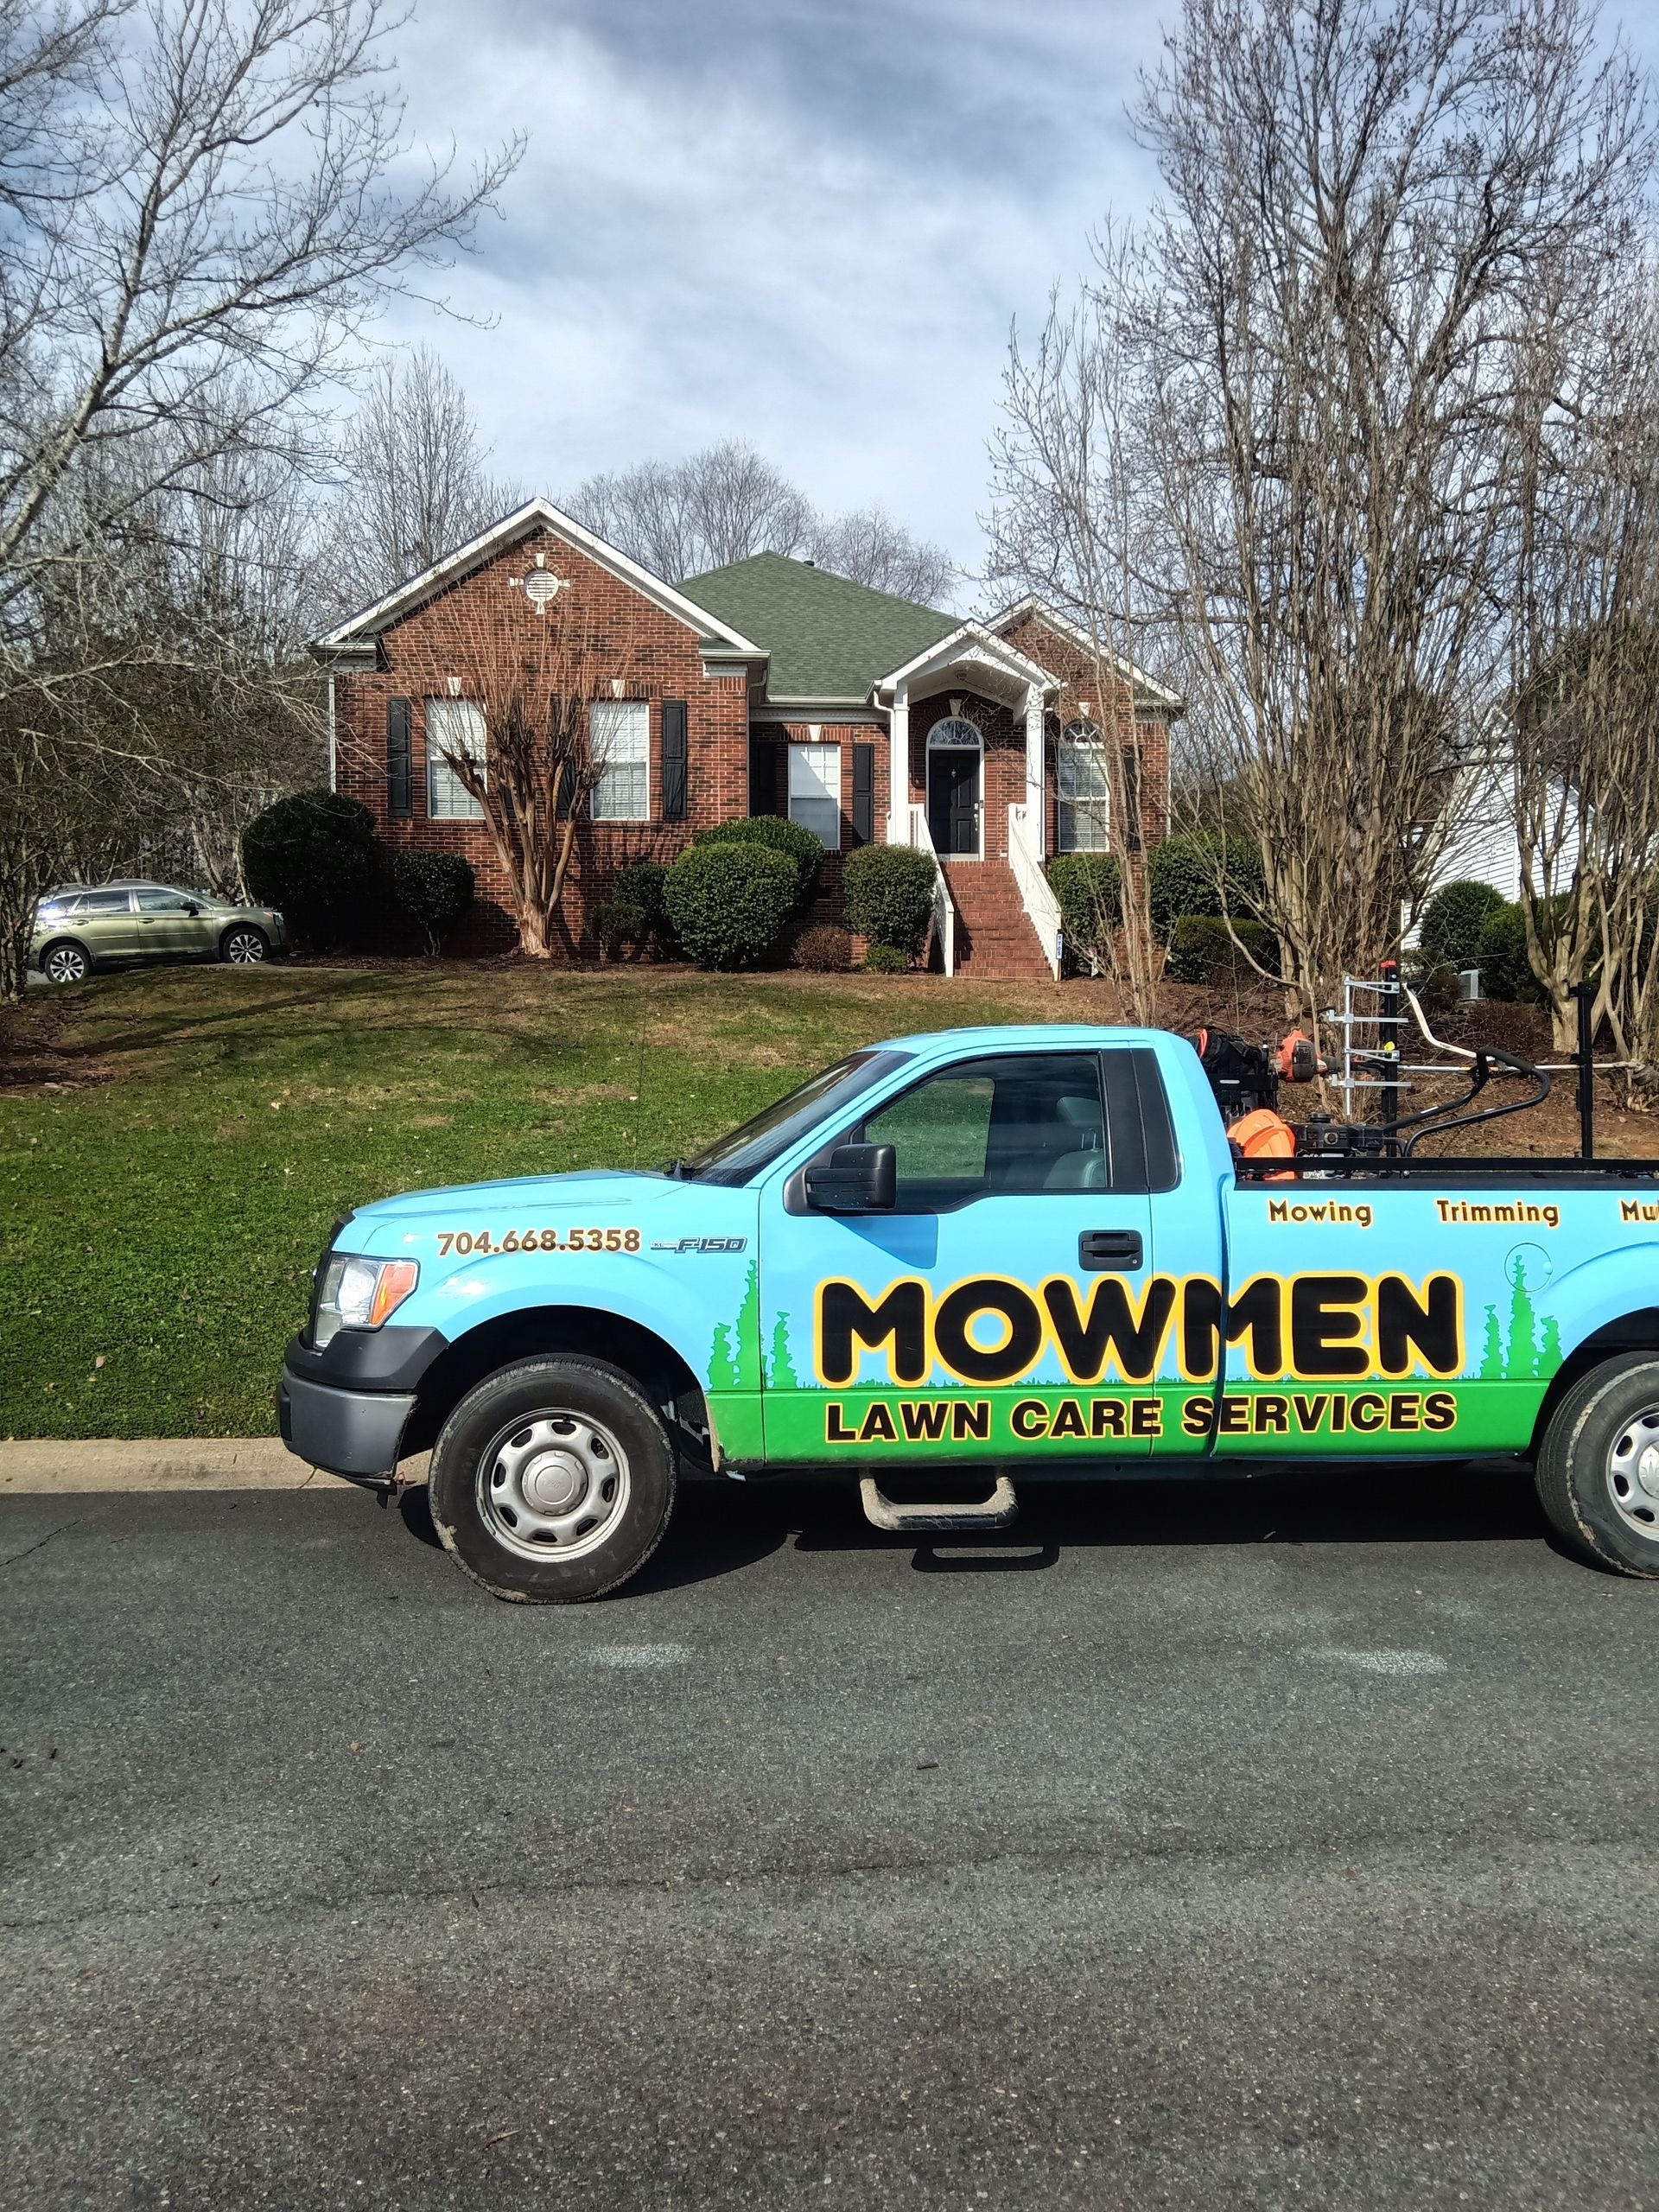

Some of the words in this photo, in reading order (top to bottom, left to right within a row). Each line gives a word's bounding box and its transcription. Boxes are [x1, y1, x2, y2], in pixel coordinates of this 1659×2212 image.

[1268, 1199, 1372, 1227] Mowing
[1436, 1199, 1560, 1227] Trimming
[436, 1228, 641, 1256] 704.668.5358
[675, 1237, 747, 1253] F-150
[815, 1272, 1463, 1389] MOWMEN
[825, 1400, 992, 1444] LAWN
[1009, 1396, 1163, 1440] CARE
[1181, 1391, 1459, 1436] SERVICES
